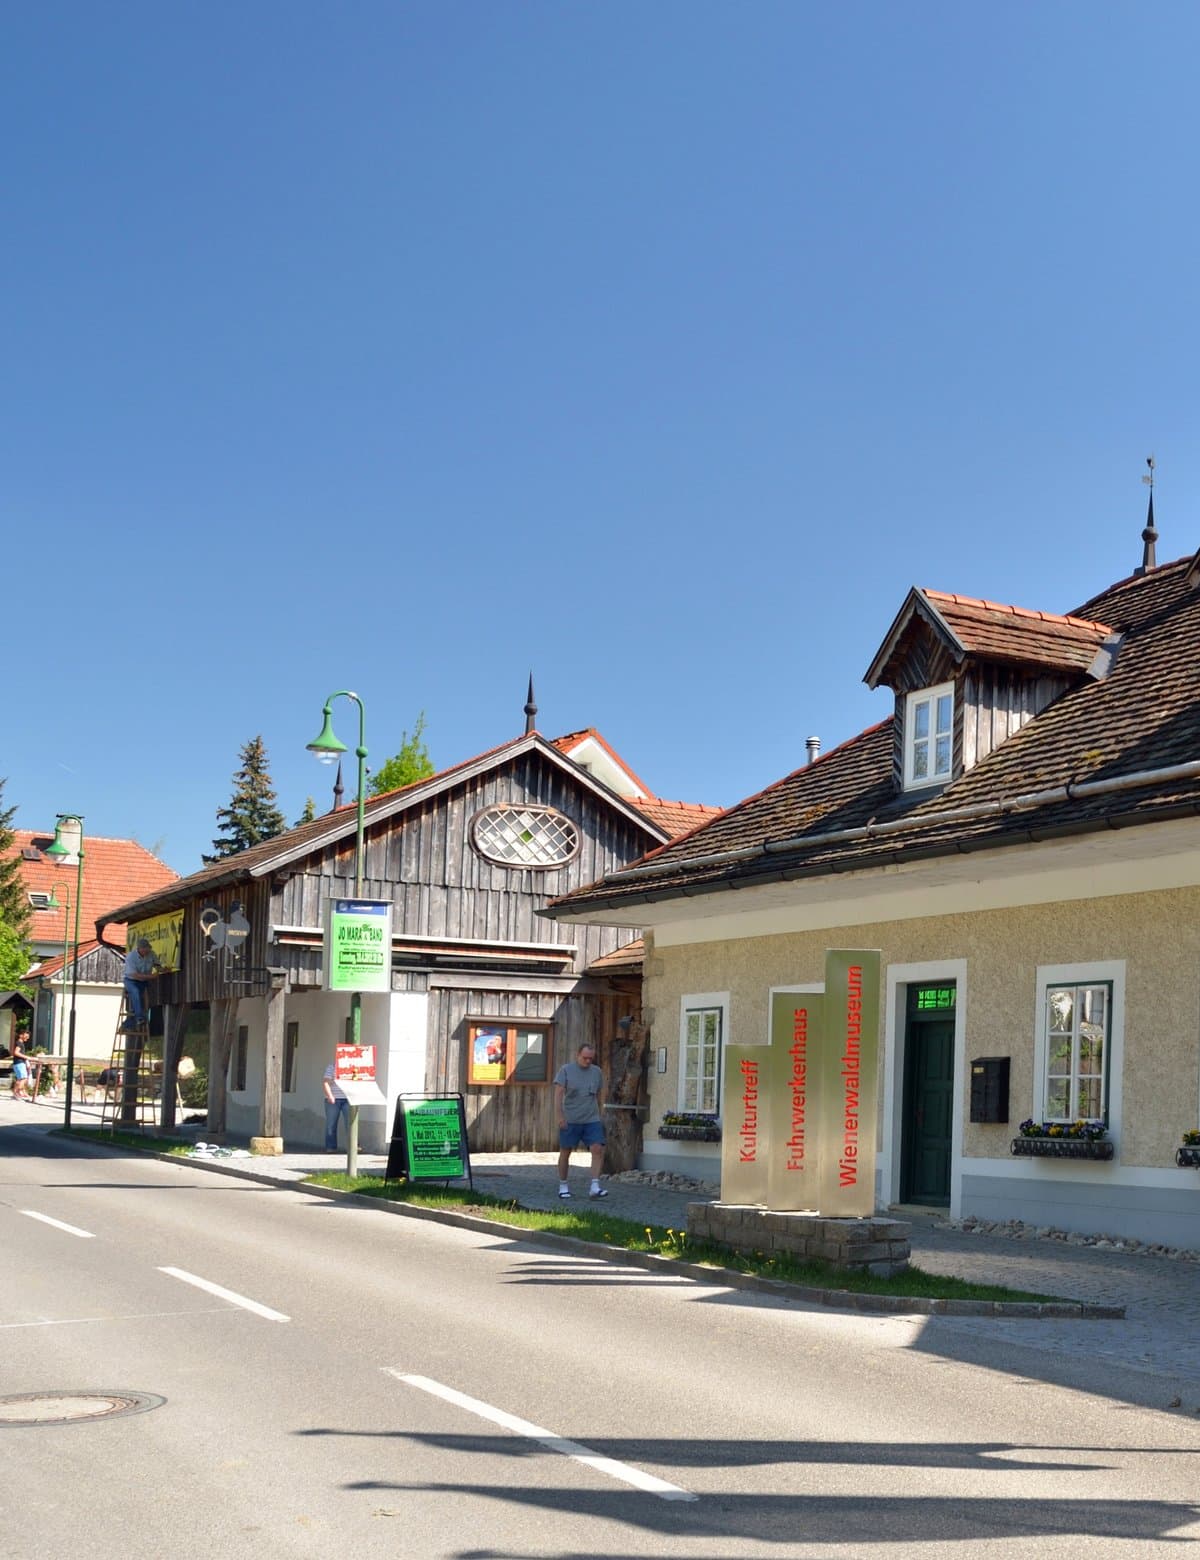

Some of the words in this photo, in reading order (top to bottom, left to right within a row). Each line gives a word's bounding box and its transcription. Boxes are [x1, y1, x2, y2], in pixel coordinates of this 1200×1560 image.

[739, 1059, 760, 1162] Kulturtreff
[786, 1007, 808, 1171] Fuhrwerkerhaus
[839, 965, 863, 1187] Wienerwaldmuseum
